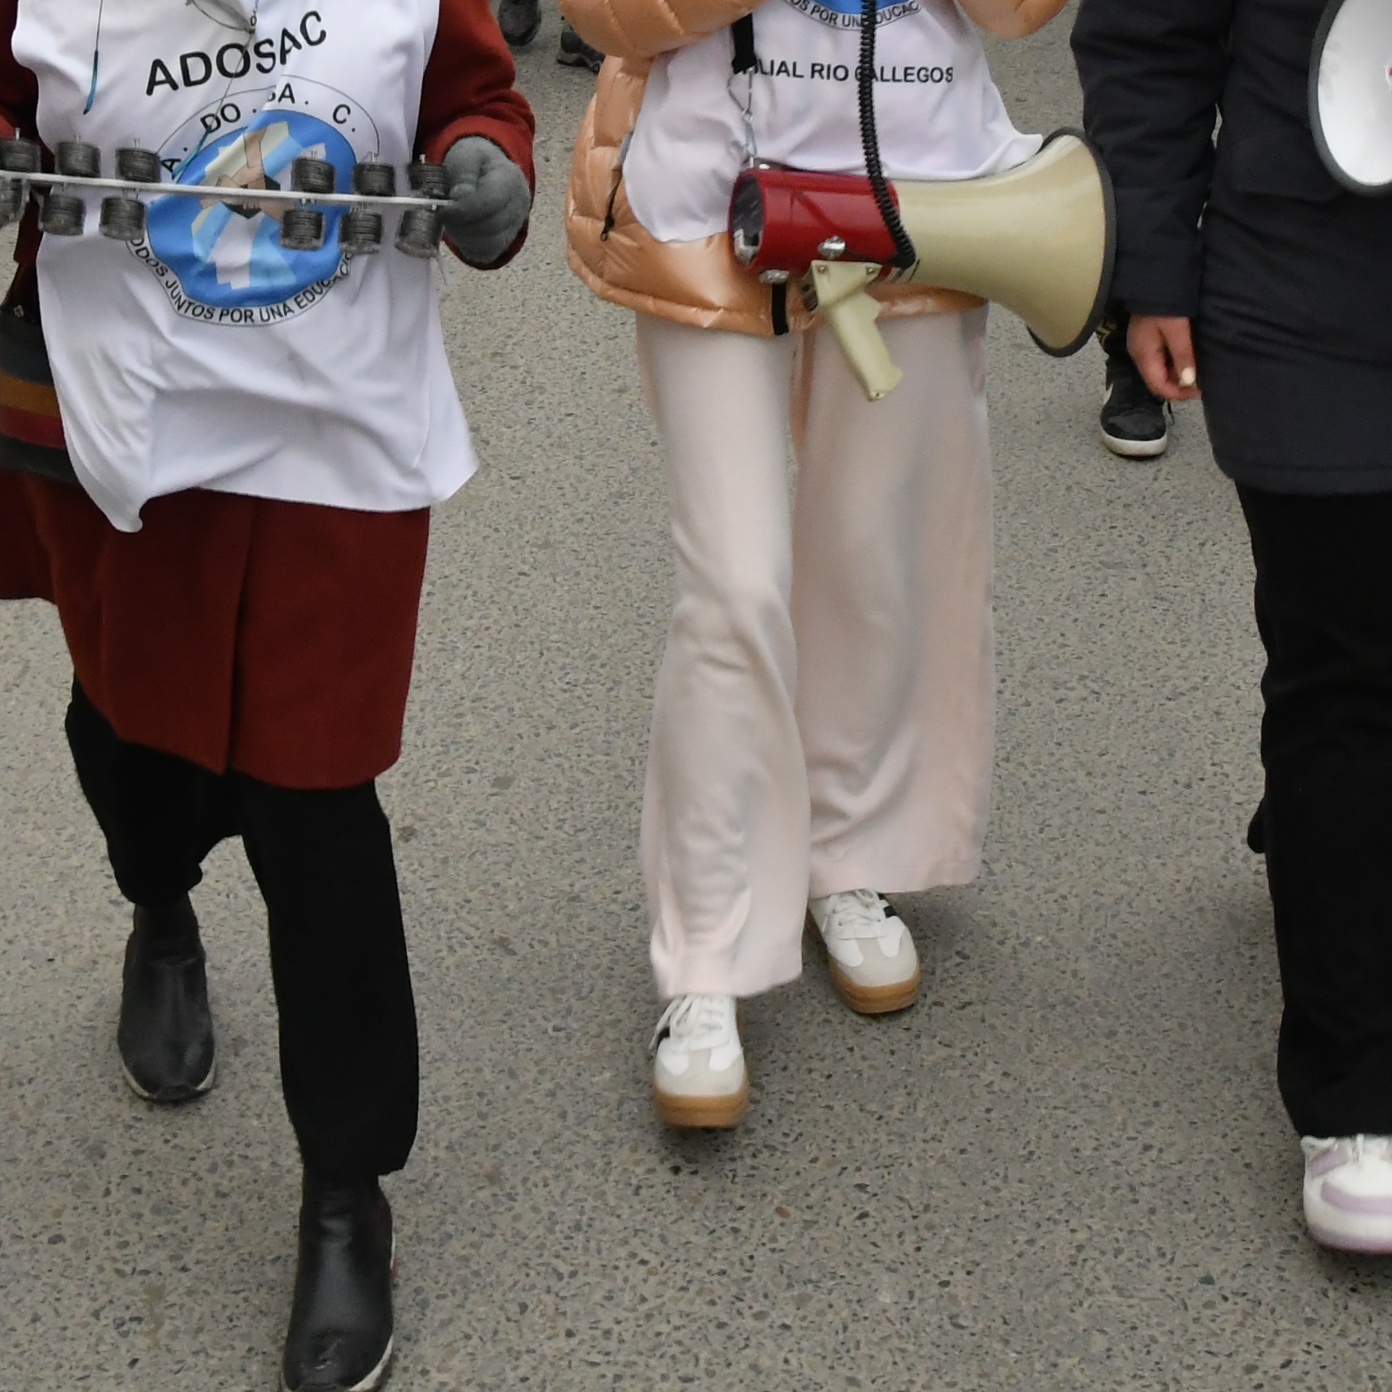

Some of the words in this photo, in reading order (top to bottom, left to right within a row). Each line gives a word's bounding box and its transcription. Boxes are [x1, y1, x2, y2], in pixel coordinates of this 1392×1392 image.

[810, 6, 838, 26] POR
[146, 10, 327, 96] ADOSAC
[810, 62, 849, 82] RIO
[165, 279, 214, 320] JUNTOS
[218, 308, 255, 324] POR
[259, 305, 296, 324] UNA
